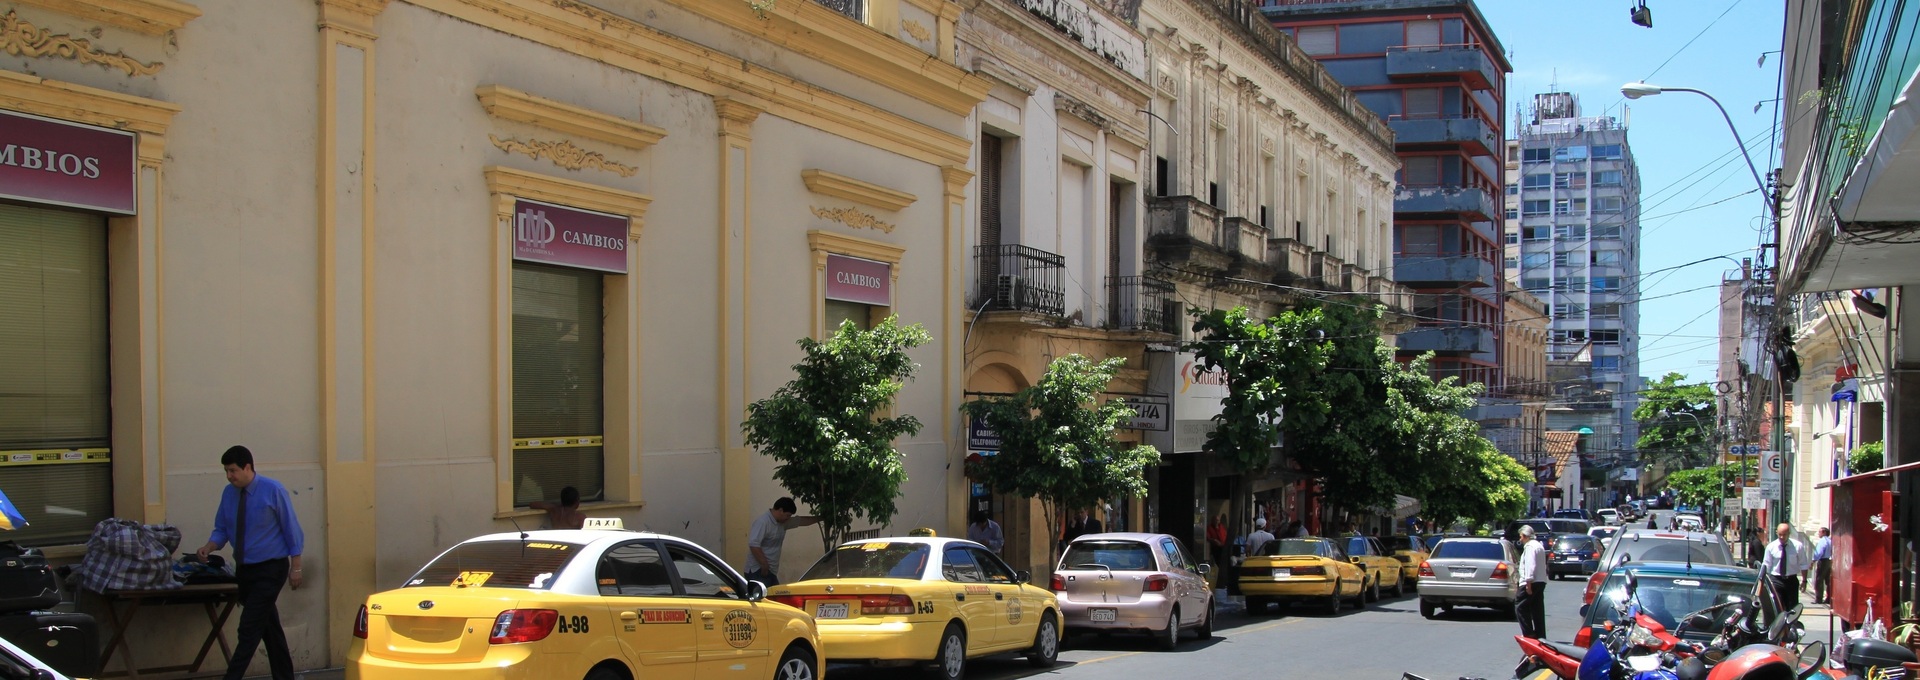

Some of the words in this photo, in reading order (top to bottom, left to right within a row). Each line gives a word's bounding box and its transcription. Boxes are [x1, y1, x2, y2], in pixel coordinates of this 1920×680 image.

[562, 230, 625, 251] CAMBIOS
[836, 271, 881, 289] CAMBIOS
[819, 609, 831, 617] ZAC
[833, 609, 846, 617] 717
[917, 600, 934, 614] A-63
[558, 615, 589, 633] A-98
[729, 623, 751, 633] 311080
[729, 632, 751, 641] 311934
